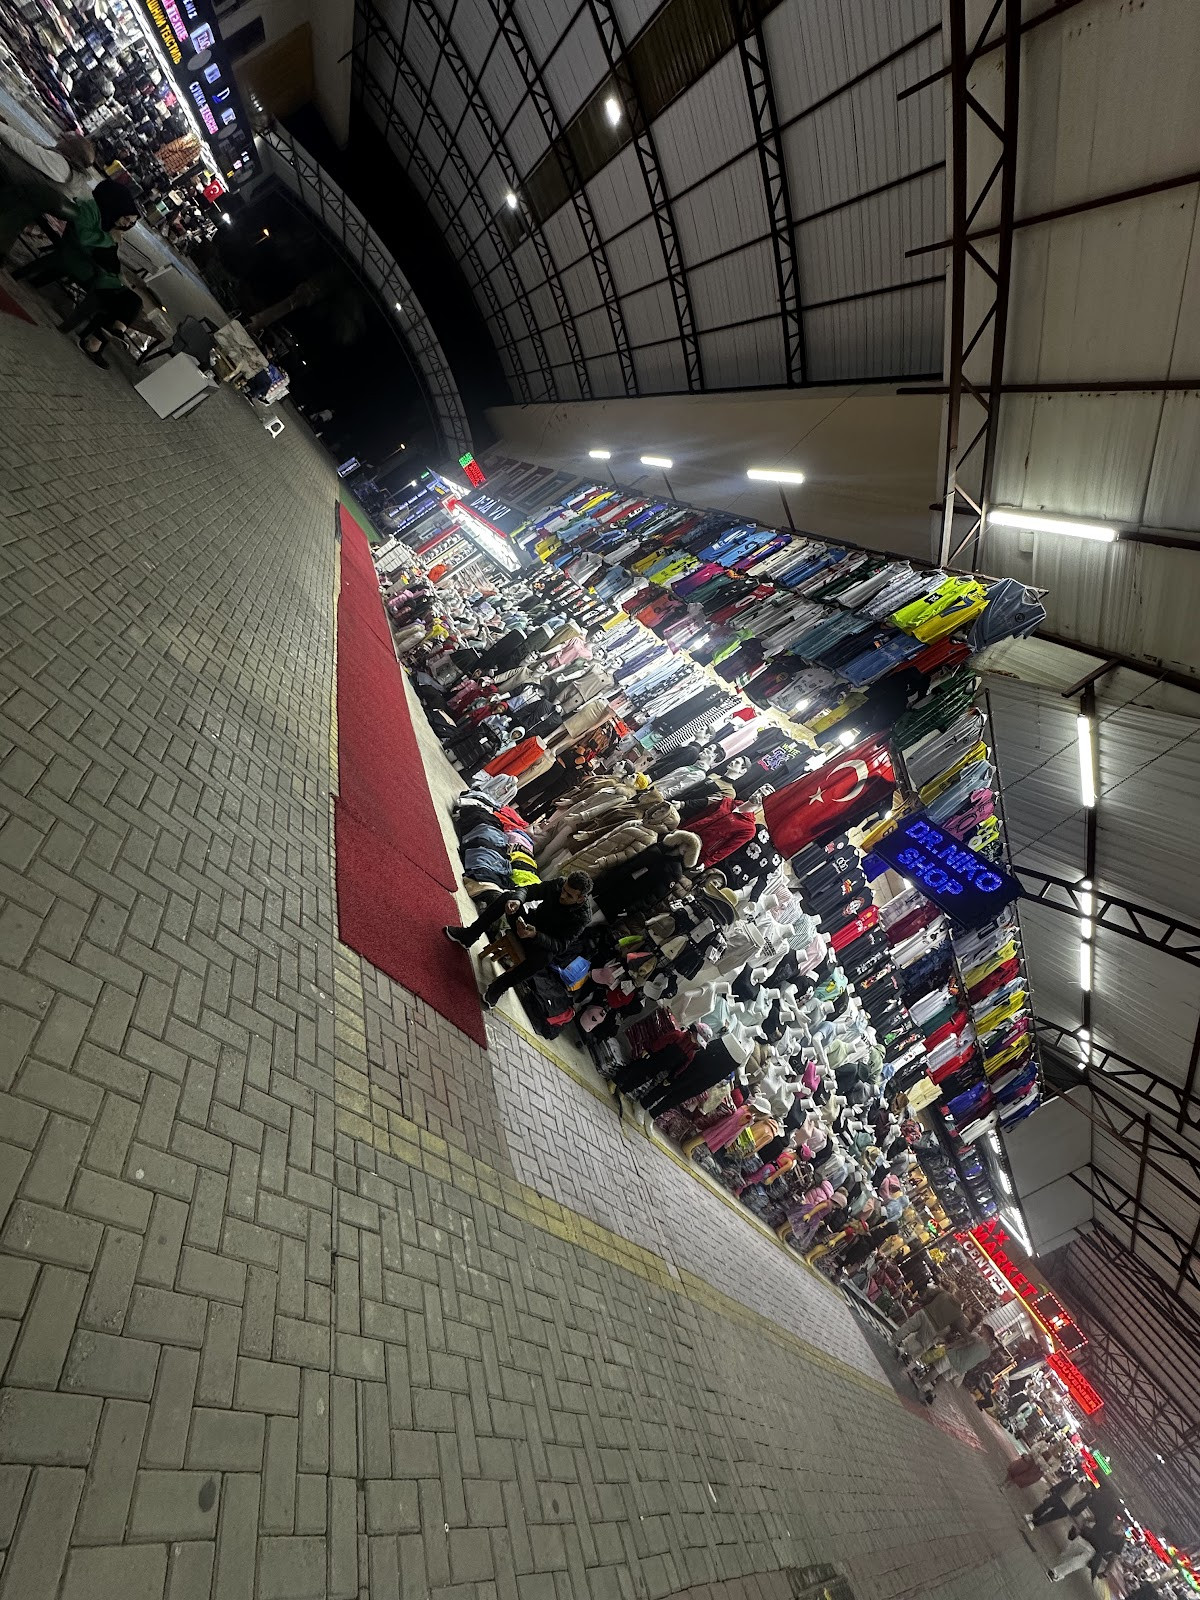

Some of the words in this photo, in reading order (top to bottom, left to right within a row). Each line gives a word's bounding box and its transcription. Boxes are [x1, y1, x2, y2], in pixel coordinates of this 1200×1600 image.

[160, 24, 183, 65] ТЕКСТИЛЬ
[488, 505, 511, 521] VU
[897, 847, 963, 895] SHOP
[970, 1224, 1038, 1297] MARKET
[1051, 1354, 1097, 1409] SOUVENIER
